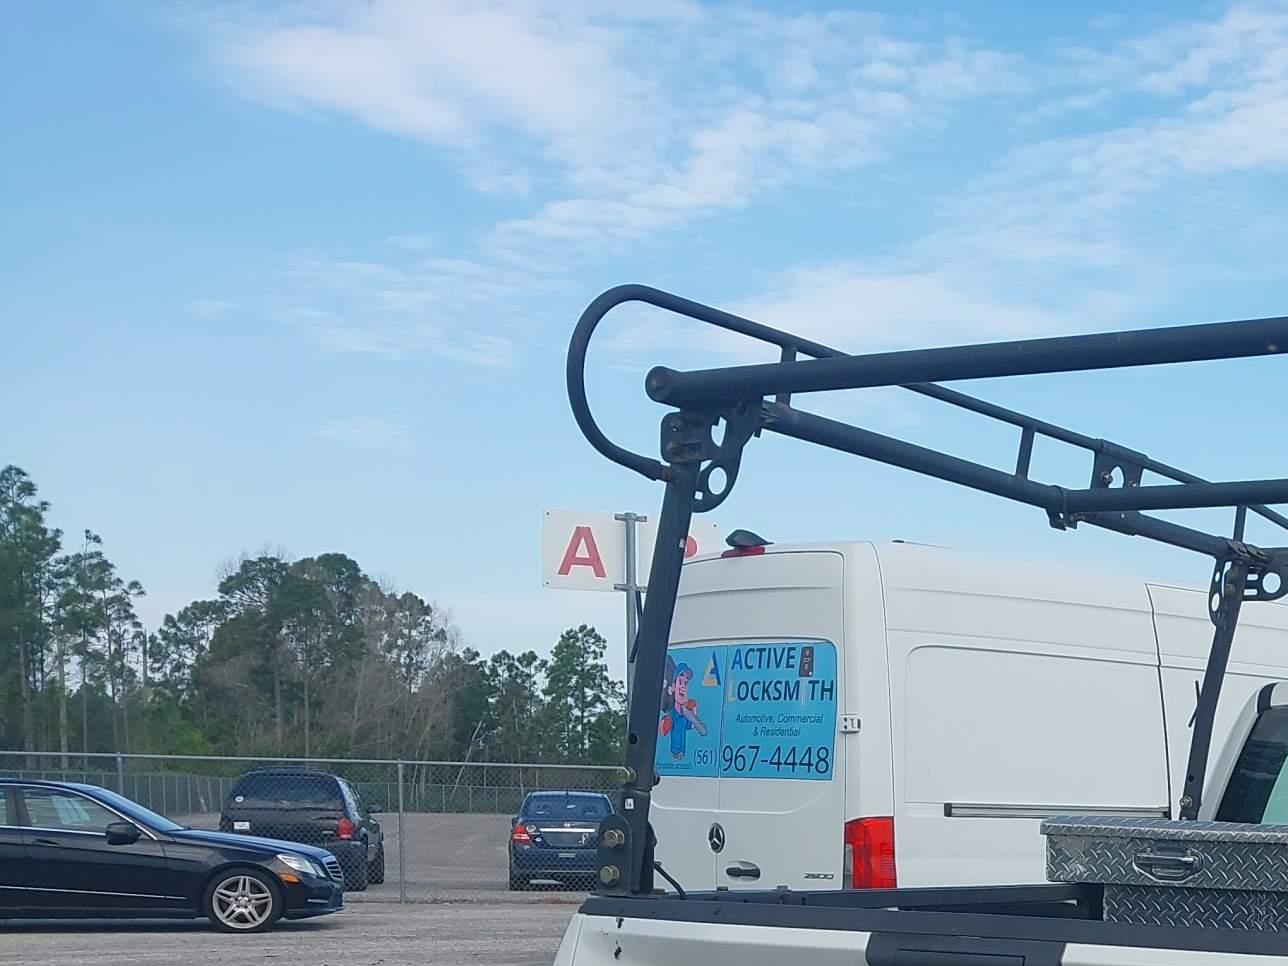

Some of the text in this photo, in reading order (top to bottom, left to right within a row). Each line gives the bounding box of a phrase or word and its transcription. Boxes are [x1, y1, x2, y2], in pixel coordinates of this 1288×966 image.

[557, 525, 607, 578] A
[731, 646, 797, 670] ACTIVE
[736, 713, 824, 724] Automotive, Commercial
[753, 726, 802, 737] & Residential
[693, 744, 830, 774] (561) 967-4448
